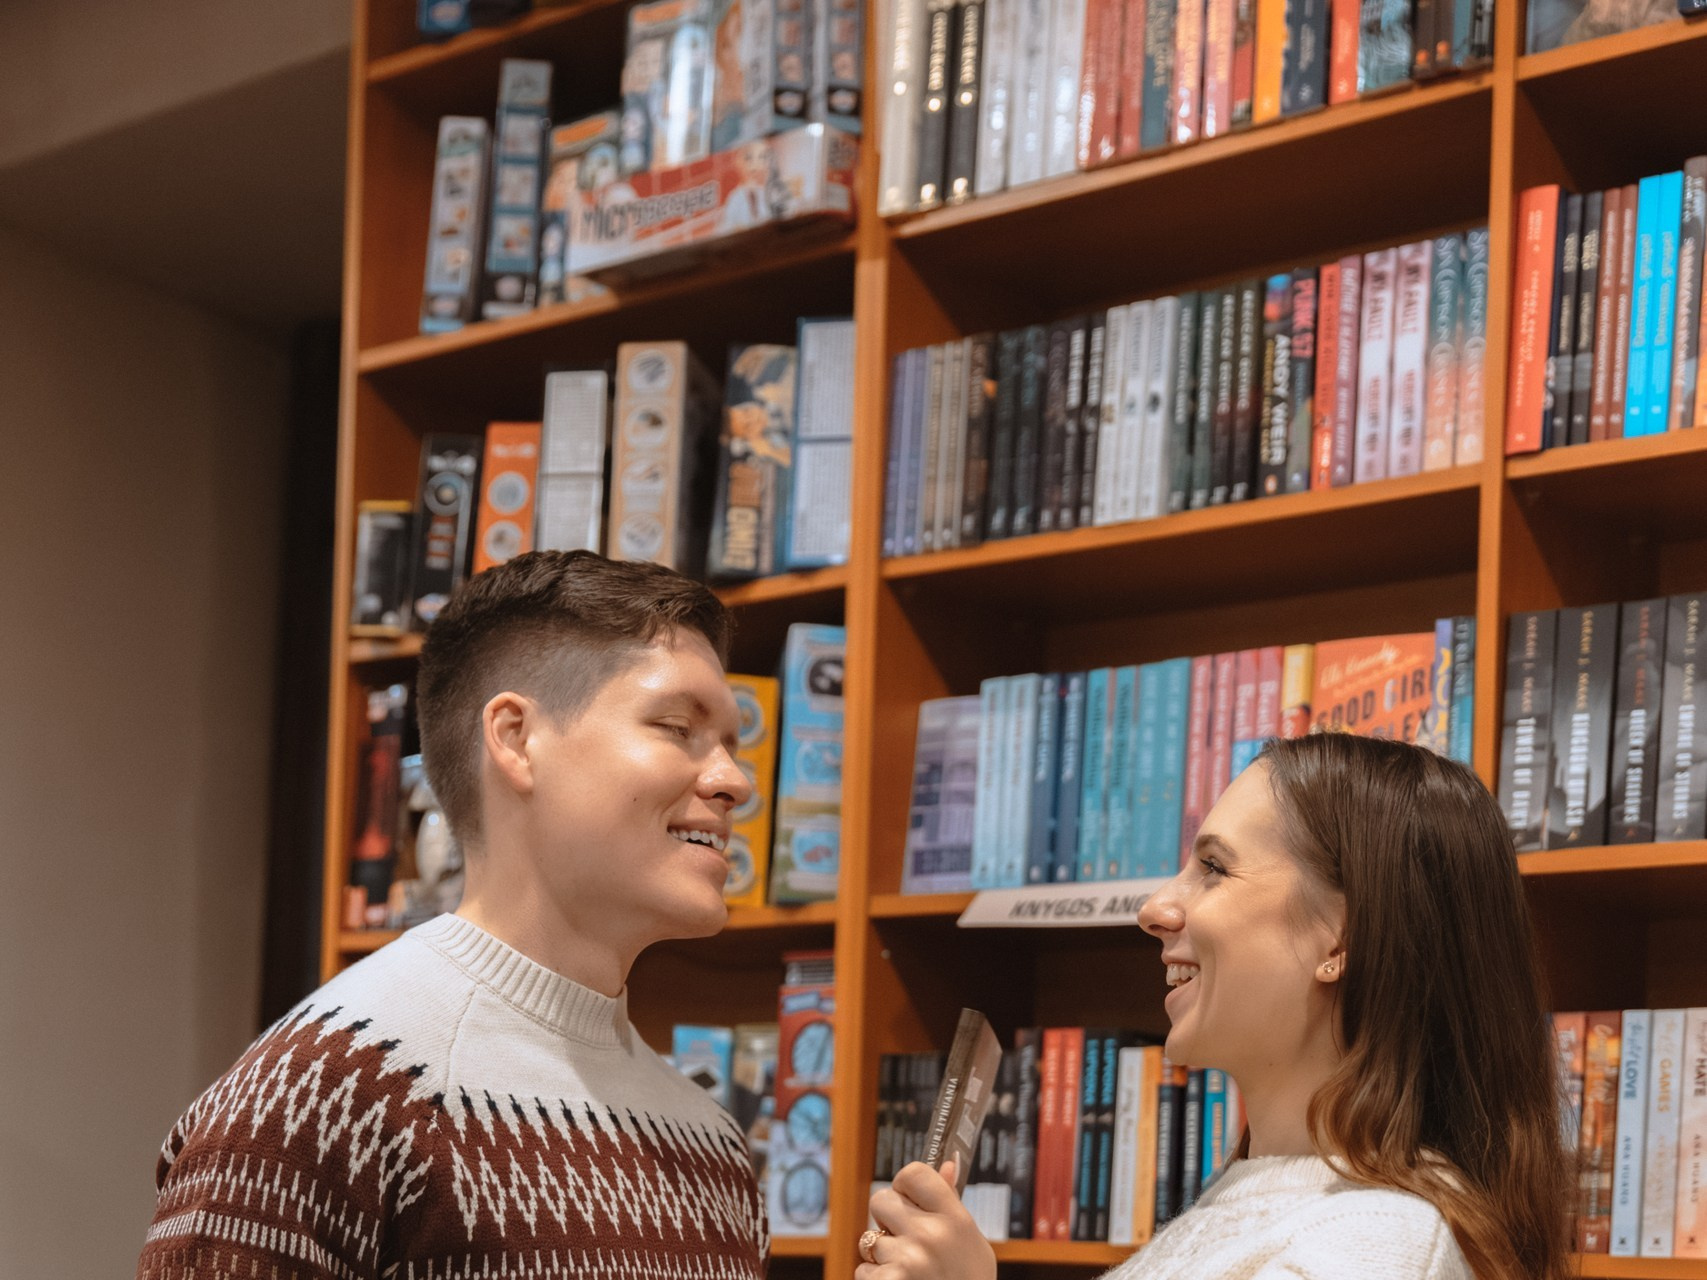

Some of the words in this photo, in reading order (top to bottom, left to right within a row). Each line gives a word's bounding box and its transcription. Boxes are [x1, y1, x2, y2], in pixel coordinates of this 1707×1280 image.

[1292, 278, 1316, 329] PUNK
[1292, 332, 1314, 358] 57
[1273, 334, 1290, 399] ANDY
[1269, 402, 1288, 465] WEIR
[1526, 616, 1538, 659] SARAH
[1580, 610, 1593, 654] SARAH
[1639, 607, 1650, 649] SARAH
[1687, 600, 1700, 643] SARAH
[1521, 676, 1534, 713] MAAS
[1576, 672, 1589, 710] MAAS
[1635, 668, 1646, 705] MAAS
[1682, 663, 1695, 700] MAAS
[1235, 683, 1255, 738] Beach
[1258, 680, 1278, 737] Beach
[1629, 709, 1647, 747] QUEEN
[1676, 704, 1696, 748] EMPIRE
[1514, 717, 1536, 764] TOWER
[1569, 713, 1591, 774] KINGDOM
[1628, 750, 1644, 764] OF
[1675, 752, 1692, 767] OF
[1513, 769, 1532, 785] OF
[1567, 779, 1586, 794] OF
[1624, 767, 1643, 824] SHADOWS
[1672, 770, 1691, 819] STORMS
[1510, 790, 1531, 829] DAWN
[1565, 800, 1585, 826] ASH
[1008, 897, 1097, 918] KNYGOS
[1623, 1059, 1639, 1099] LOVE
[1657, 1058, 1673, 1113] GAMES
[927, 1134, 941, 1167] AVOUR
[935, 1078, 958, 1132] LITHUANIA
[1623, 1136, 1632, 1159] ANA
[1620, 1164, 1631, 1205] HUANG
